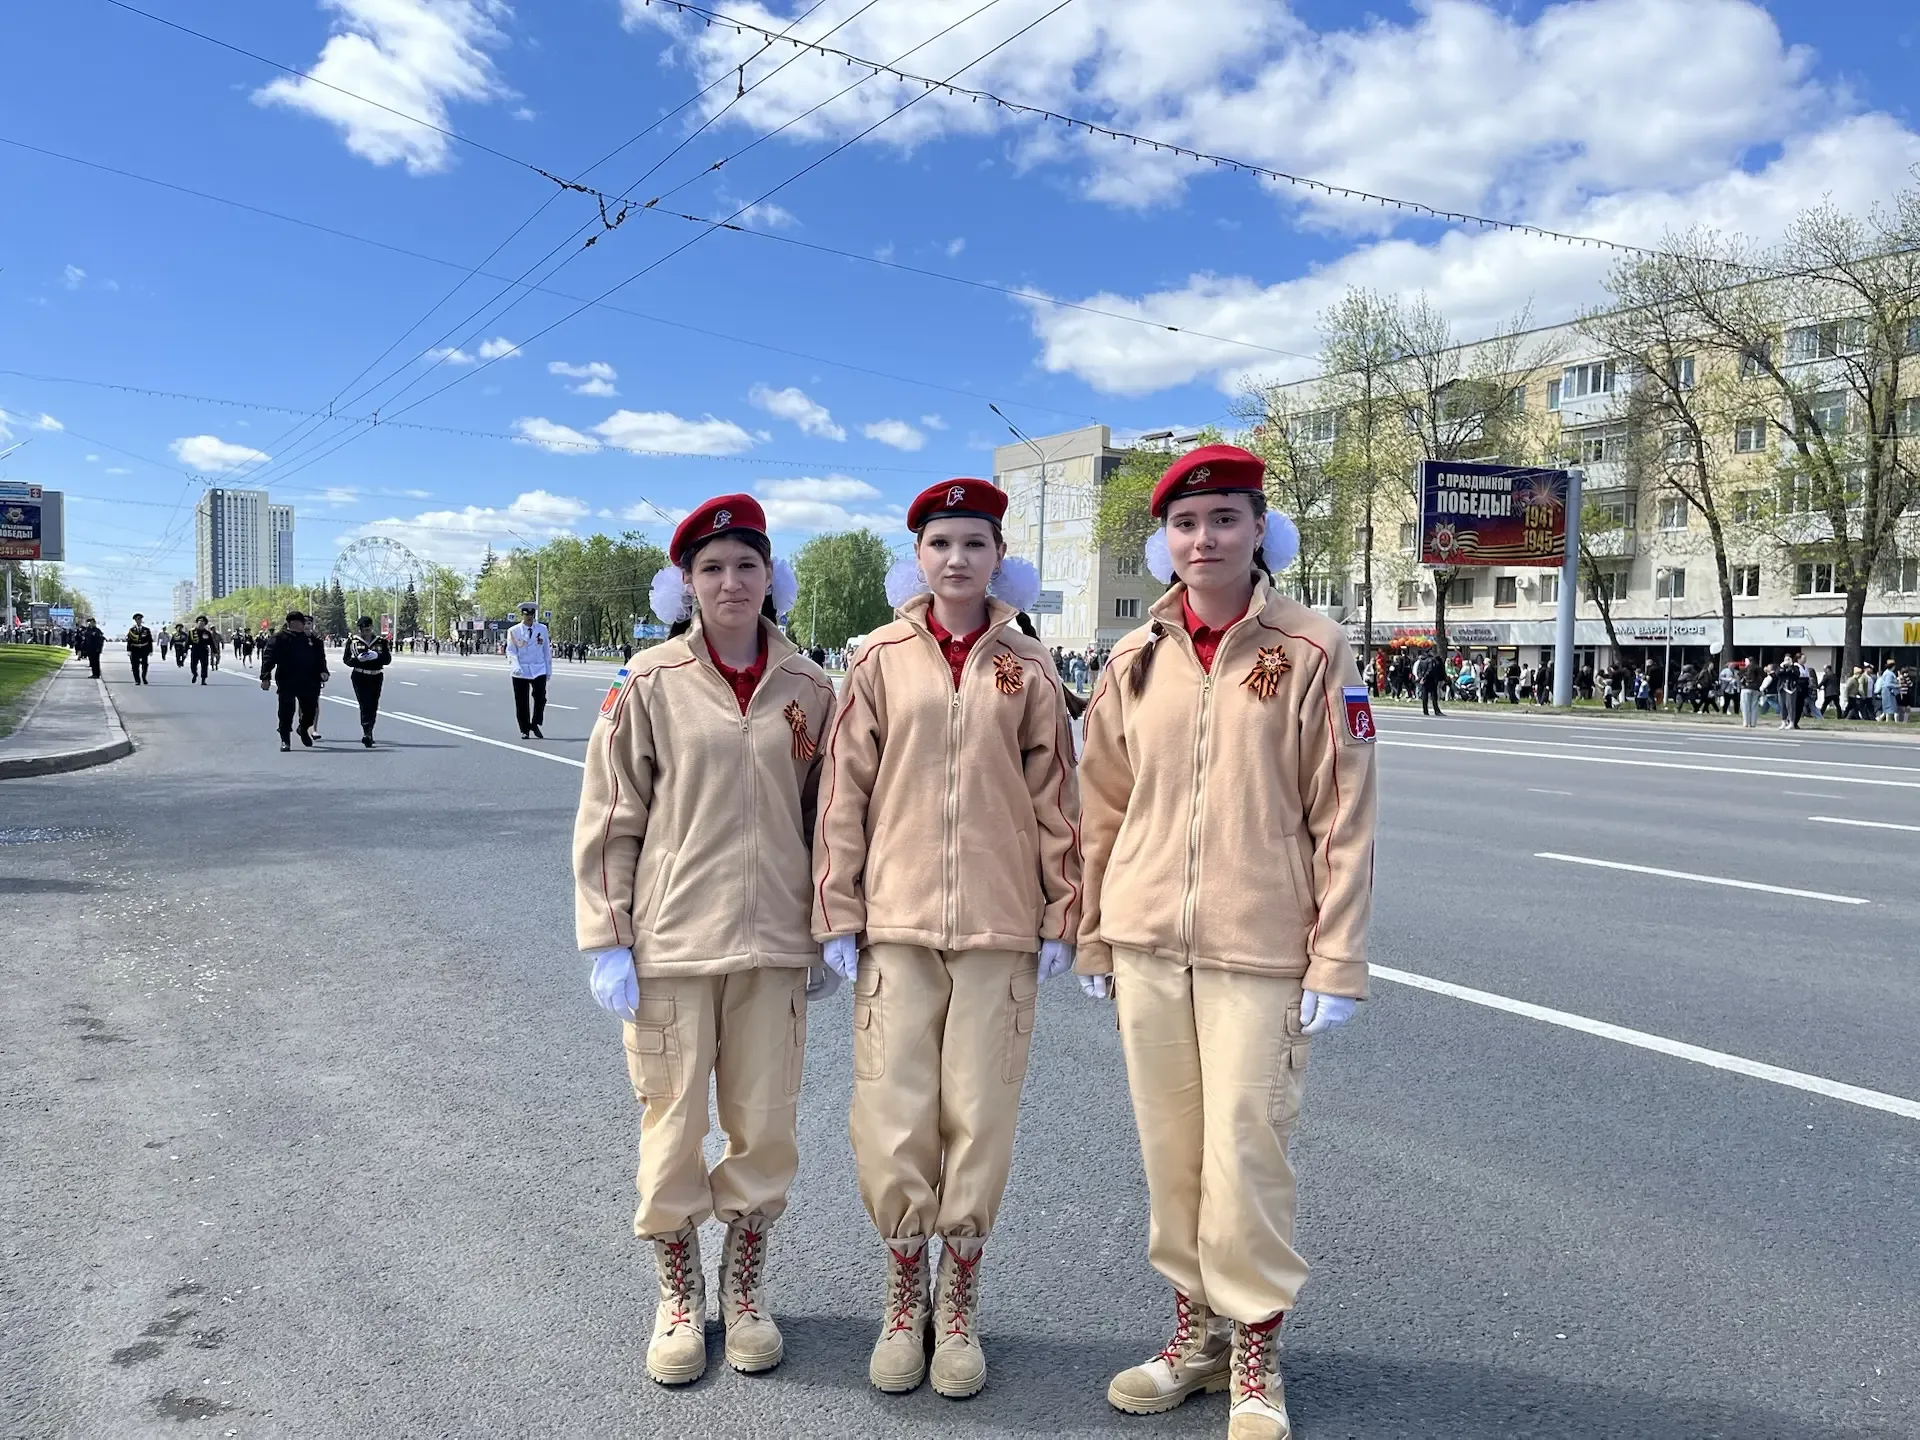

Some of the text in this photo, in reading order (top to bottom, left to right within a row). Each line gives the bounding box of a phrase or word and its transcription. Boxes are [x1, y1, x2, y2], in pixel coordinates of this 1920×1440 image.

[1437, 472, 1513, 492] С ПРАЗДНИКОМ
[1437, 490, 1512, 519] ПОБЕДЫ!
[1524, 504, 1554, 529] 1941
[1521, 529, 1554, 552] 1945
[1612, 625, 1706, 635] АМА ВАРИ КОФЕ
